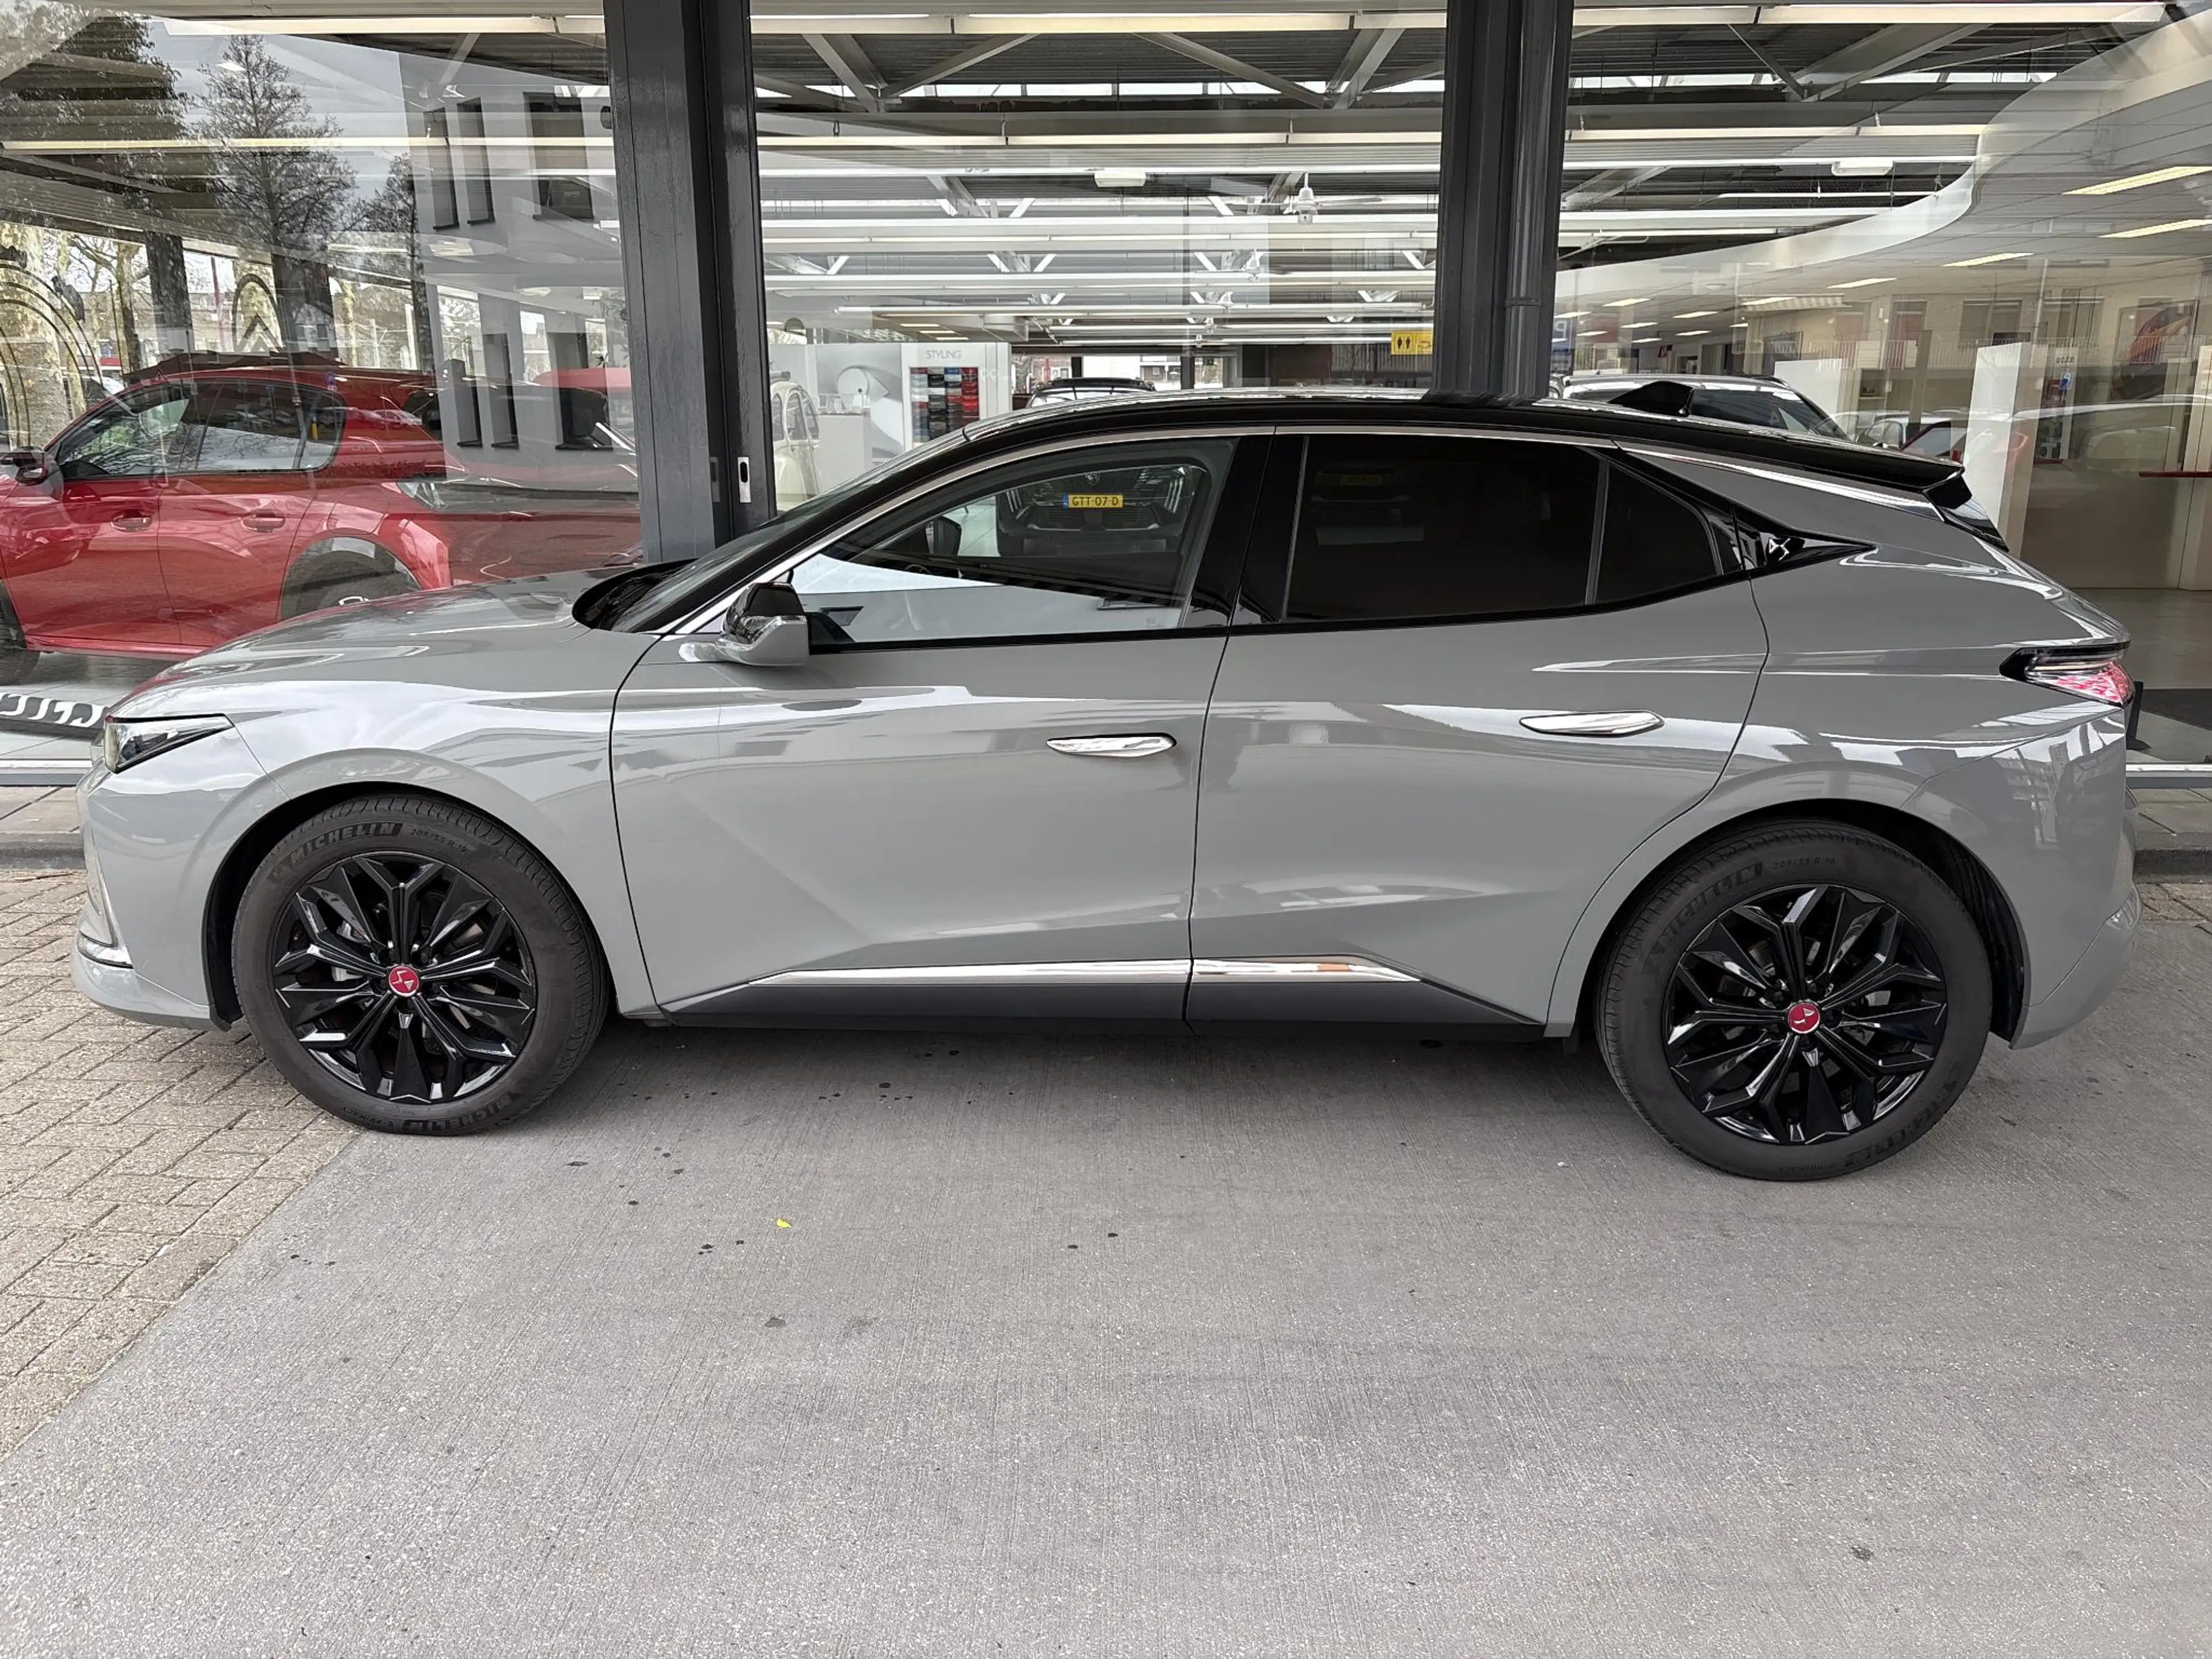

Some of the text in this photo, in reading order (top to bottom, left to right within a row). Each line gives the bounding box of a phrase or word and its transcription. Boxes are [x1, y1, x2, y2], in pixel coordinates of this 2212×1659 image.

[926, 350, 961, 359] STYLING
[1072, 497, 1119, 506] GTT-07-D
[290, 823, 395, 863] MICHELIN
[409, 1094, 512, 1131] MICHELIN
